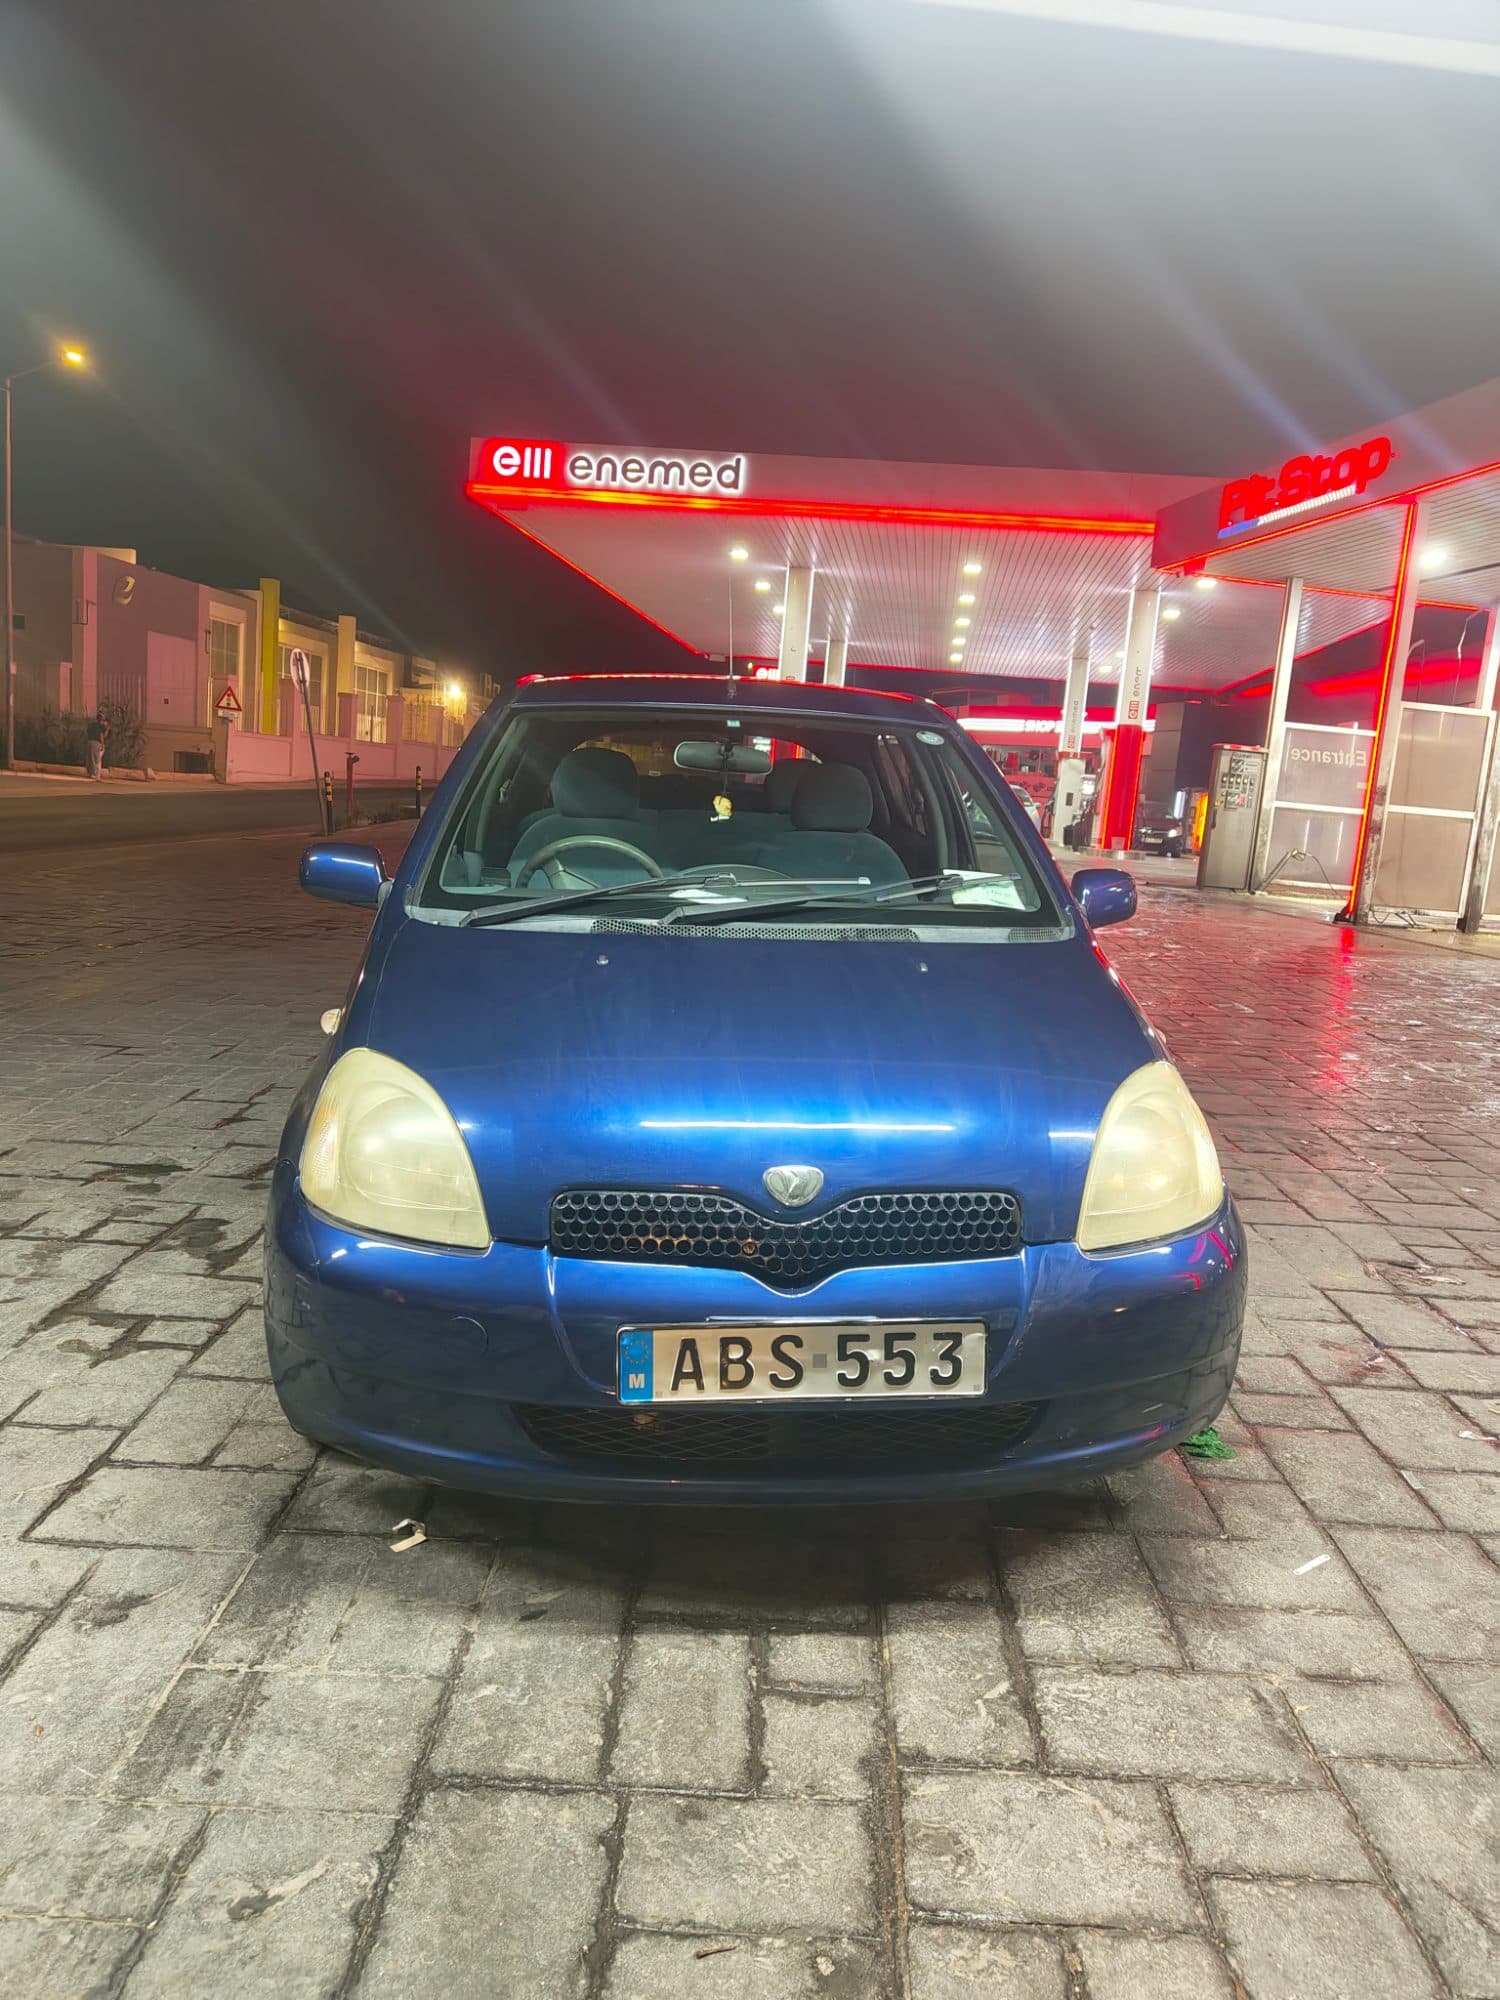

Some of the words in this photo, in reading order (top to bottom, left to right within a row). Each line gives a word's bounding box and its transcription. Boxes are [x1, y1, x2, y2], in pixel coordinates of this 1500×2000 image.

[567, 455, 742, 492] enemed
[1278, 437, 1391, 506] Stop
[628, 1373, 645, 1389] M
[671, 1335, 804, 1392] ABS
[836, 1332, 963, 1388] 553
